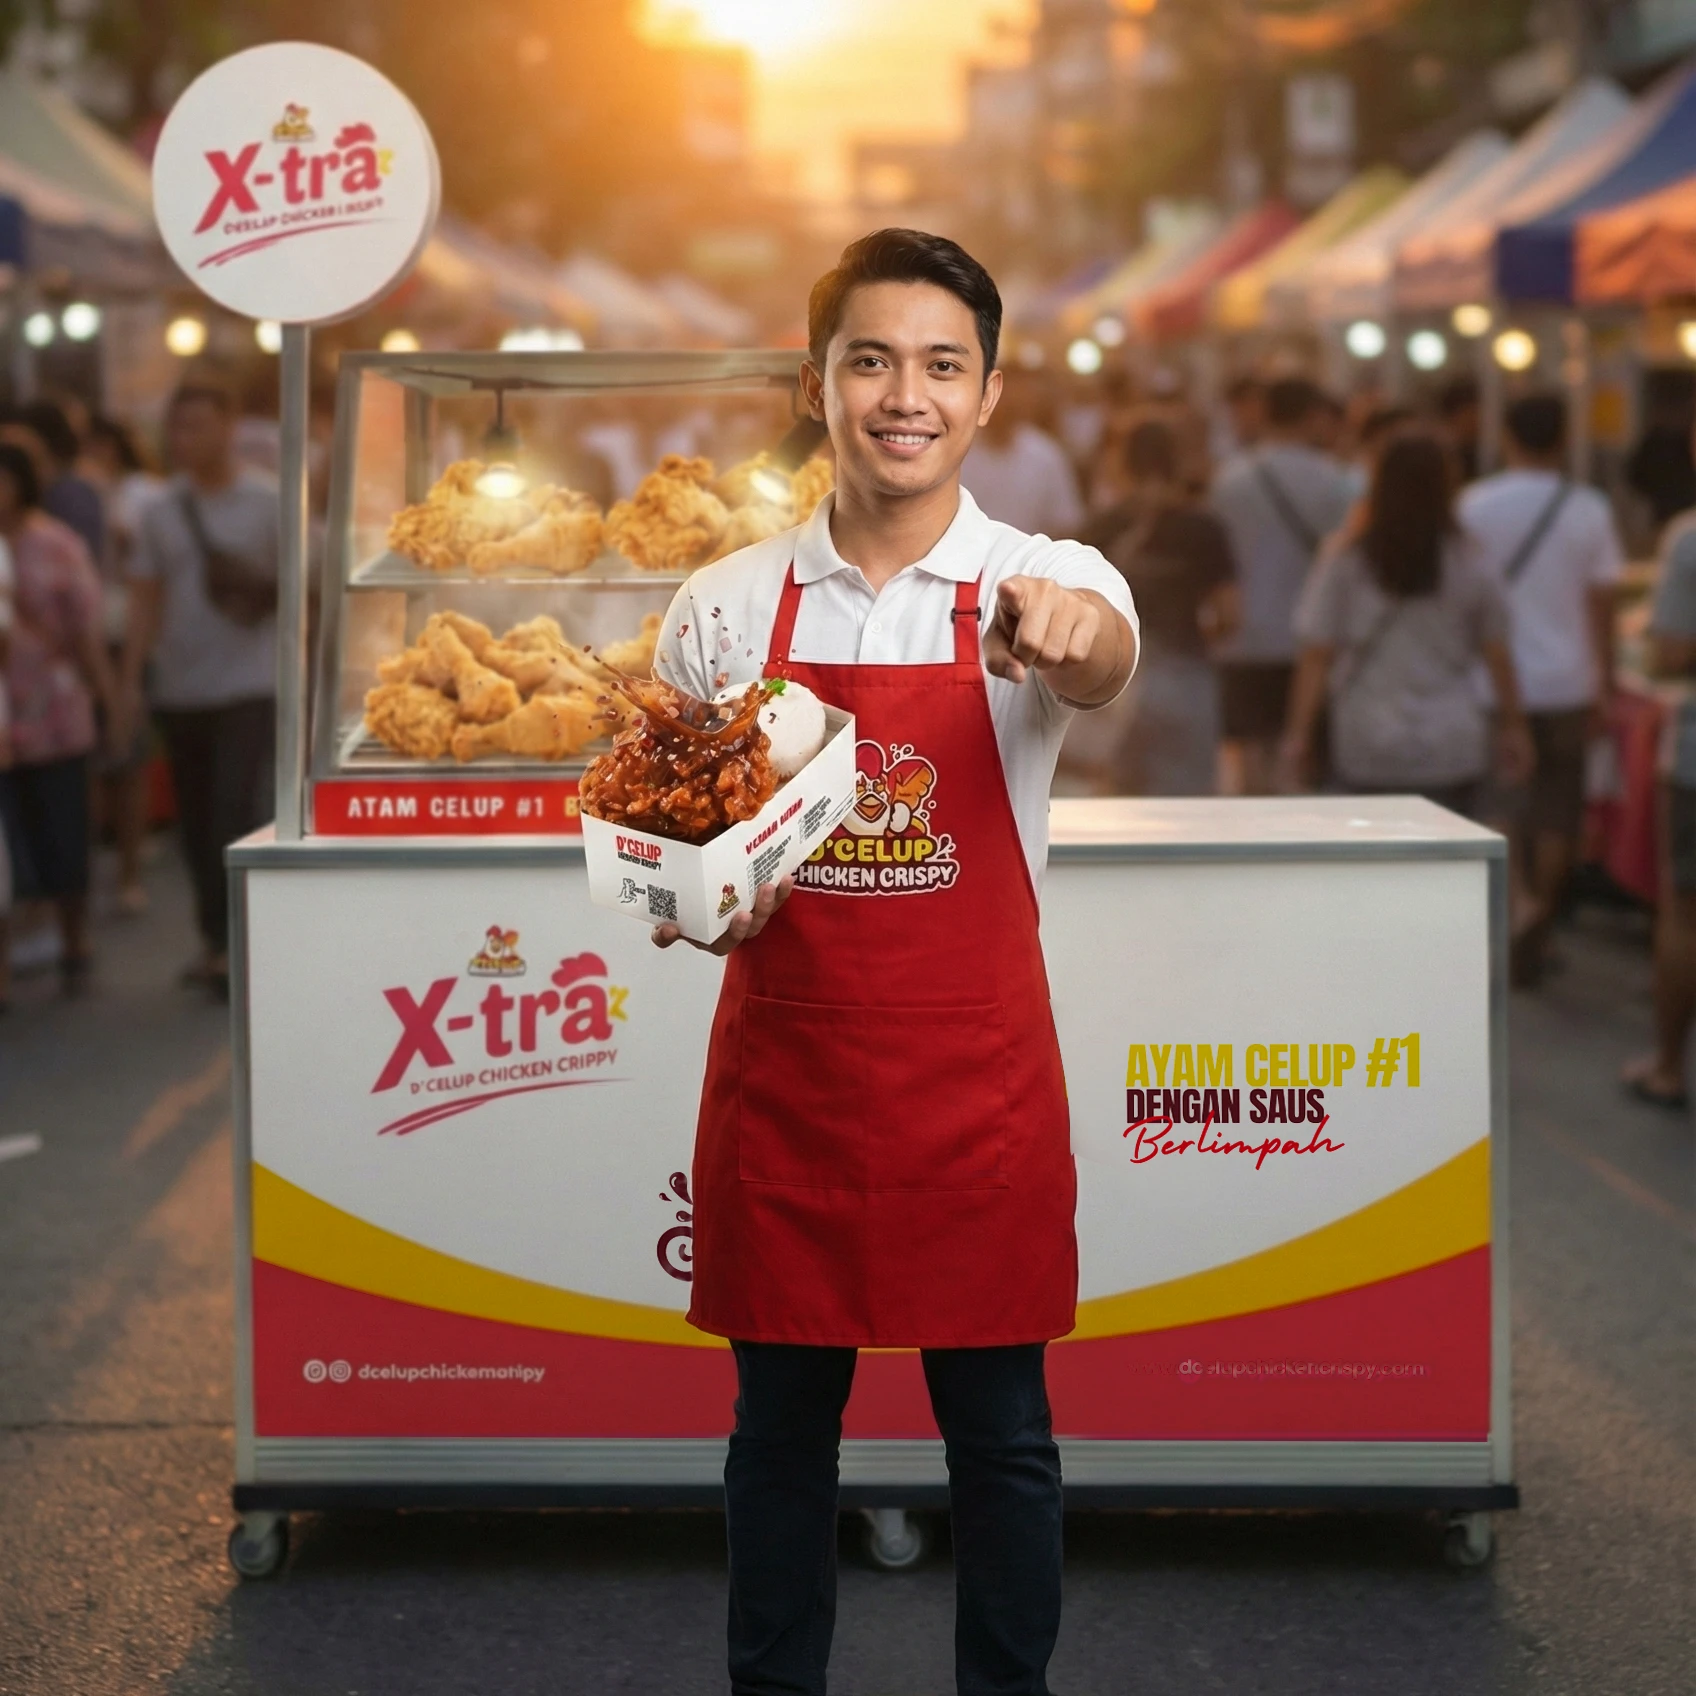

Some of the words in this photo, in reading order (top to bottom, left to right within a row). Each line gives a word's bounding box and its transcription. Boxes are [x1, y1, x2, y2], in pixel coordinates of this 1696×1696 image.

[348, 797, 418, 818] ATAM
[430, 797, 505, 818] CELUP
[516, 797, 544, 818] #1
[616, 835, 662, 862] D'CELUP
[794, 865, 875, 888] HICKEN
[880, 866, 954, 888] CRISPY
[410, 1072, 475, 1095] D'CELUP
[478, 1058, 552, 1086] CHICKEN
[557, 1048, 618, 1073] CRIPPY
[1126, 1043, 1233, 1087] AYAM
[1245, 1043, 1355, 1087] CELUP
[1366, 1032, 1420, 1087] #1
[1126, 1088, 1240, 1124] DENGAN
[1249, 1088, 1325, 1124] SAUS
[1122, 1110, 1345, 1170] Berlimpah
